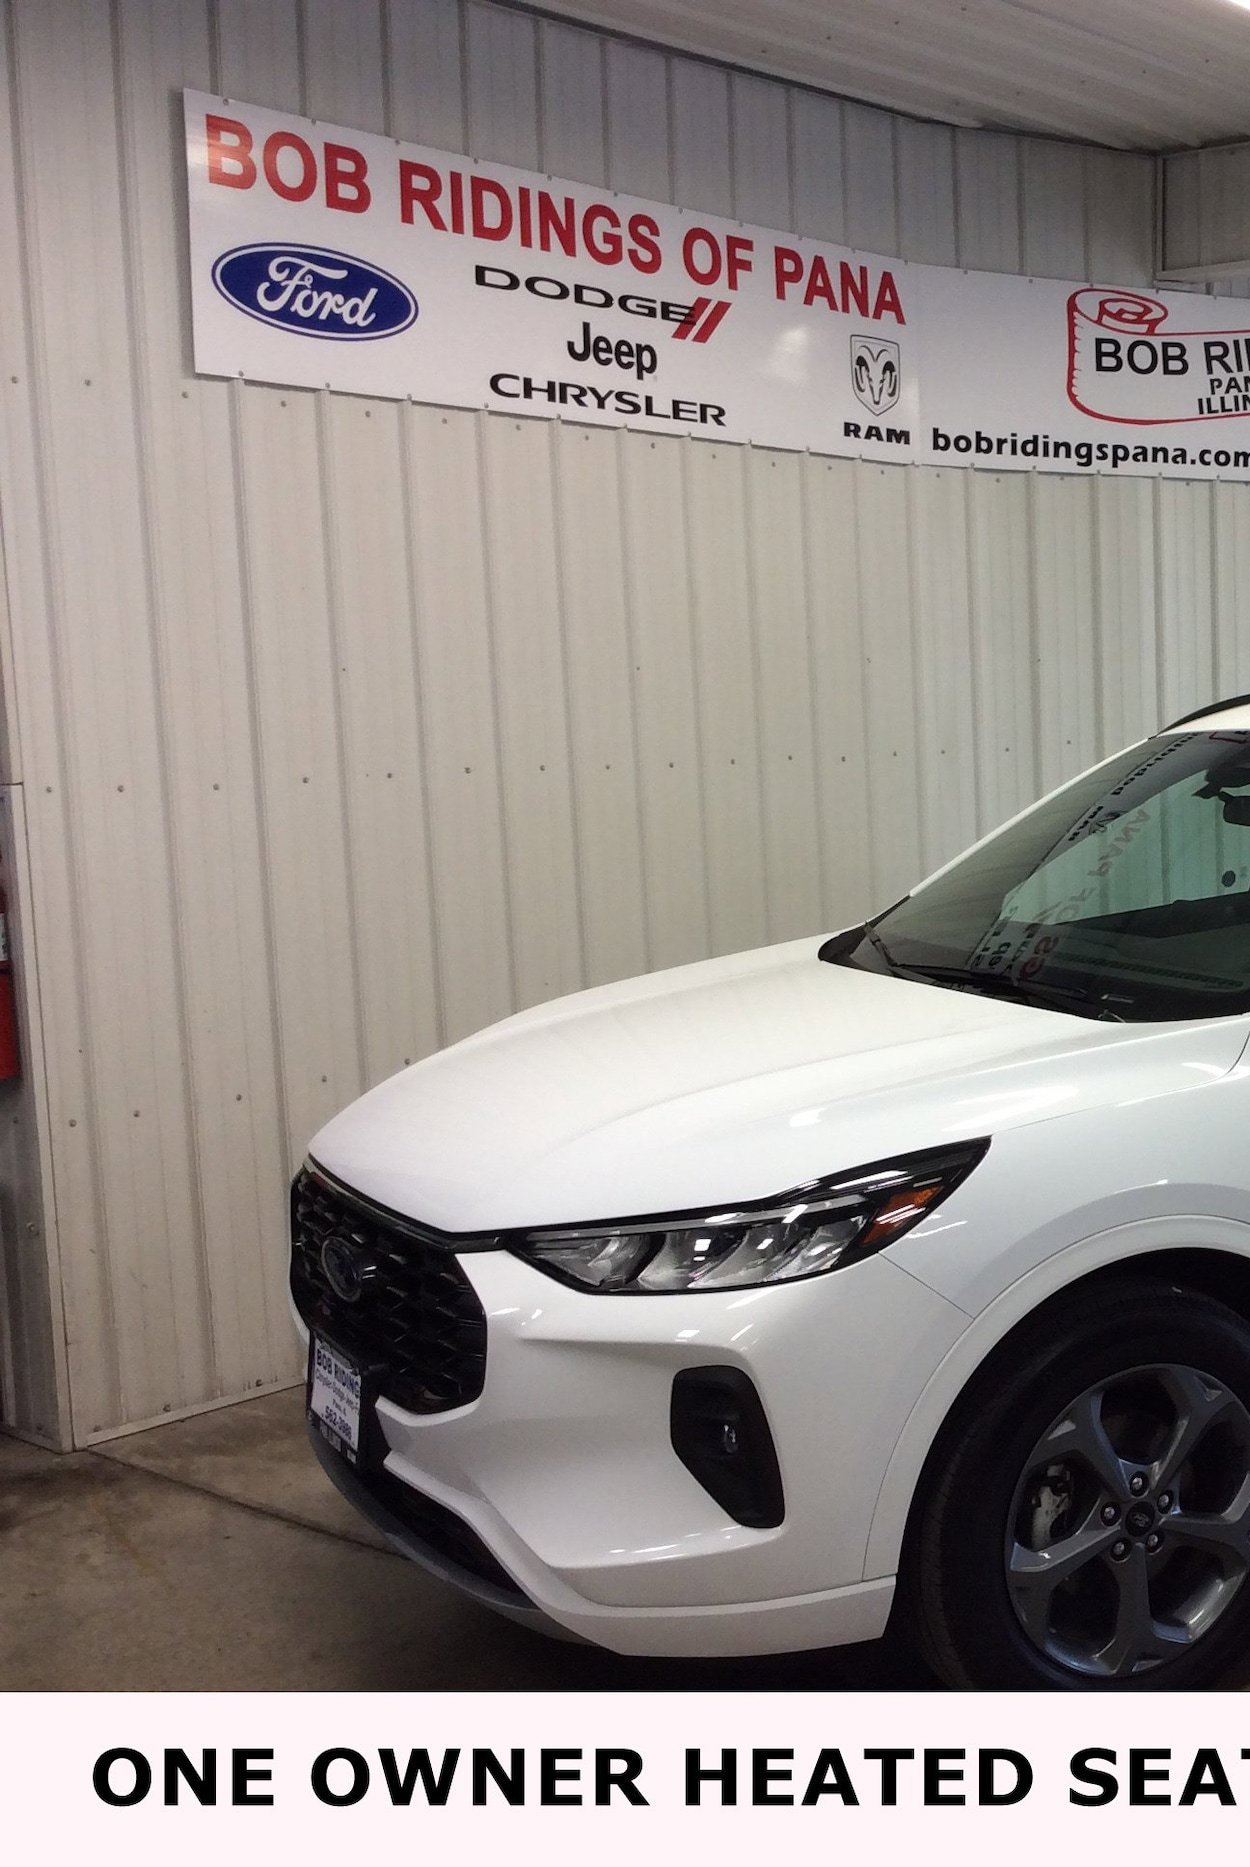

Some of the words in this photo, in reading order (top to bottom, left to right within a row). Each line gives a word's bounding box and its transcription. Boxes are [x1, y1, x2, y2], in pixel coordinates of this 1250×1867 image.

[205, 113, 372, 213] BOB
[399, 160, 662, 275] RIDINGS
[683, 228, 754, 292] OF
[774, 246, 906, 325] PANA
[257, 254, 378, 328] Ford
[475, 264, 697, 323] DODGE
[566, 321, 658, 380] Jeep
[1094, 336, 1190, 377] BOB
[489, 373, 727, 427] CHRYSLER
[844, 421, 911, 445] RAM
